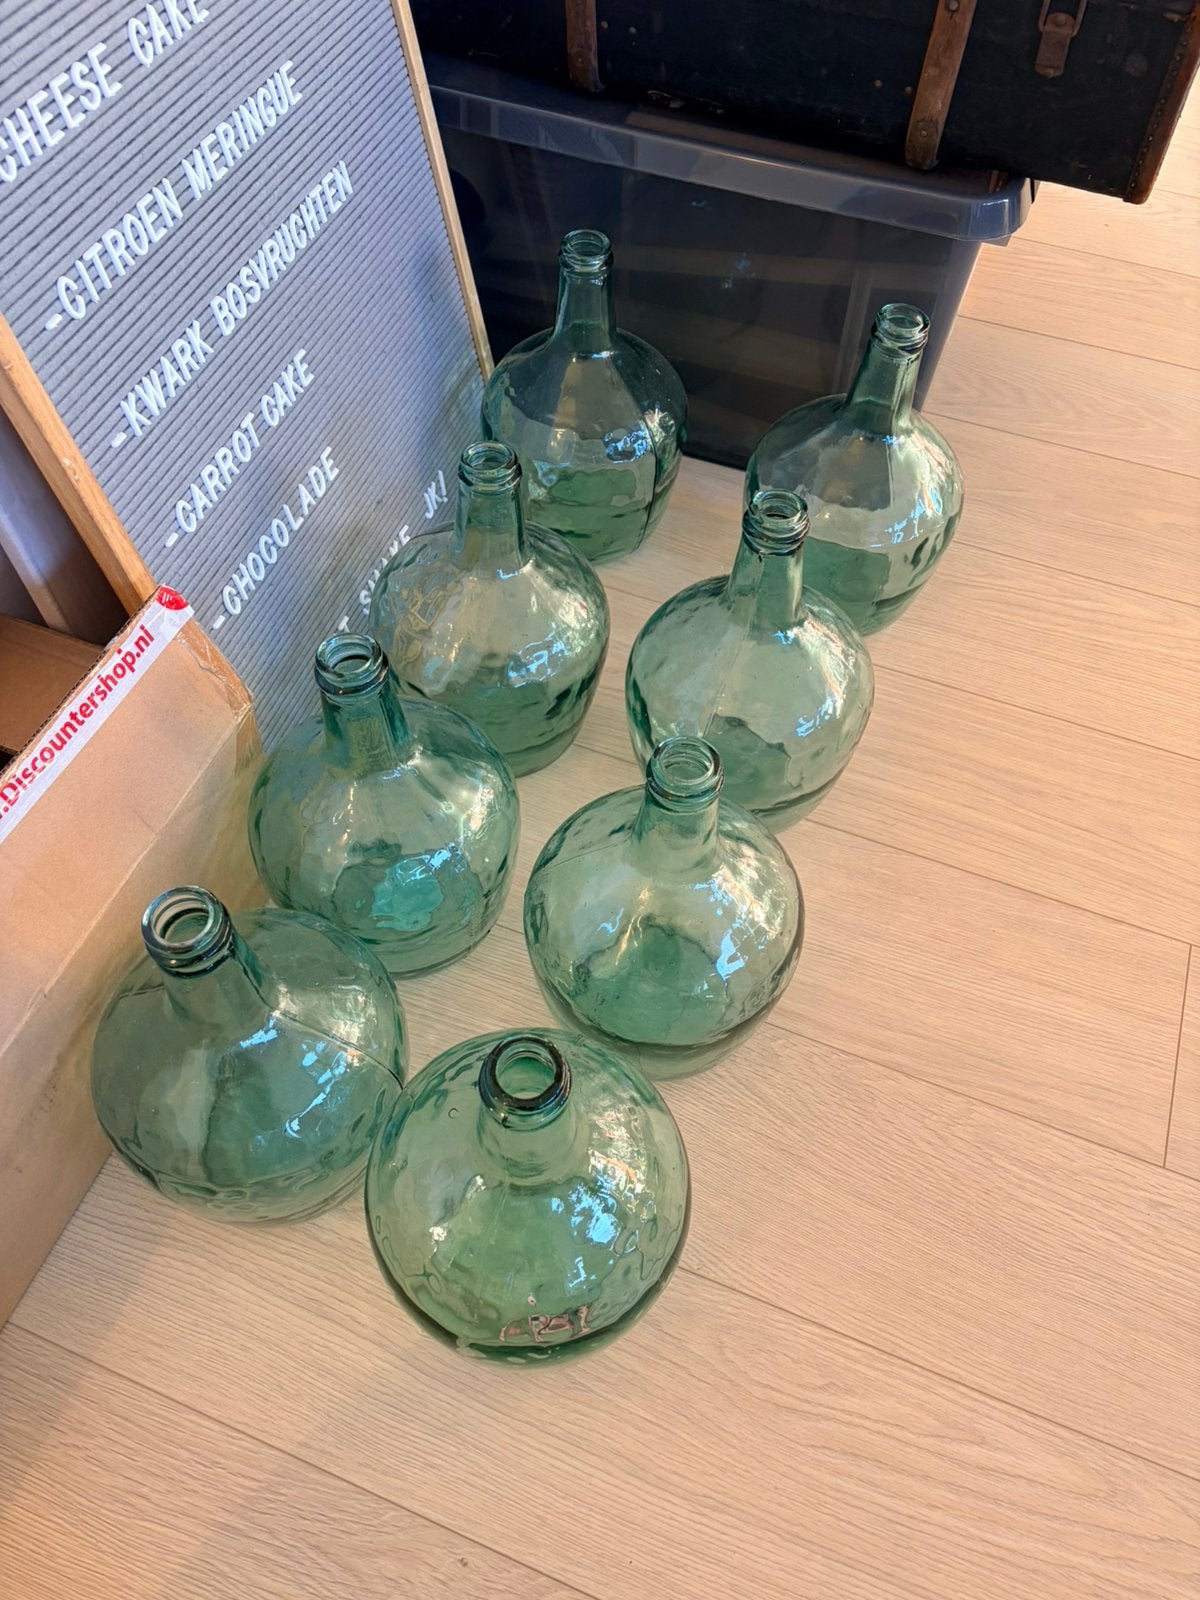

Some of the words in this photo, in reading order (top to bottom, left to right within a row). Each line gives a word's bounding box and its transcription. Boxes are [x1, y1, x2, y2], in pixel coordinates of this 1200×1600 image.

[181, 60, 303, 200] MERINGUE
[210, 160, 353, 337] BOSVRUCHTEN
[260, 348, 315, 428] CAKE
[0, 625, 155, 820] .Discountershop.nl
